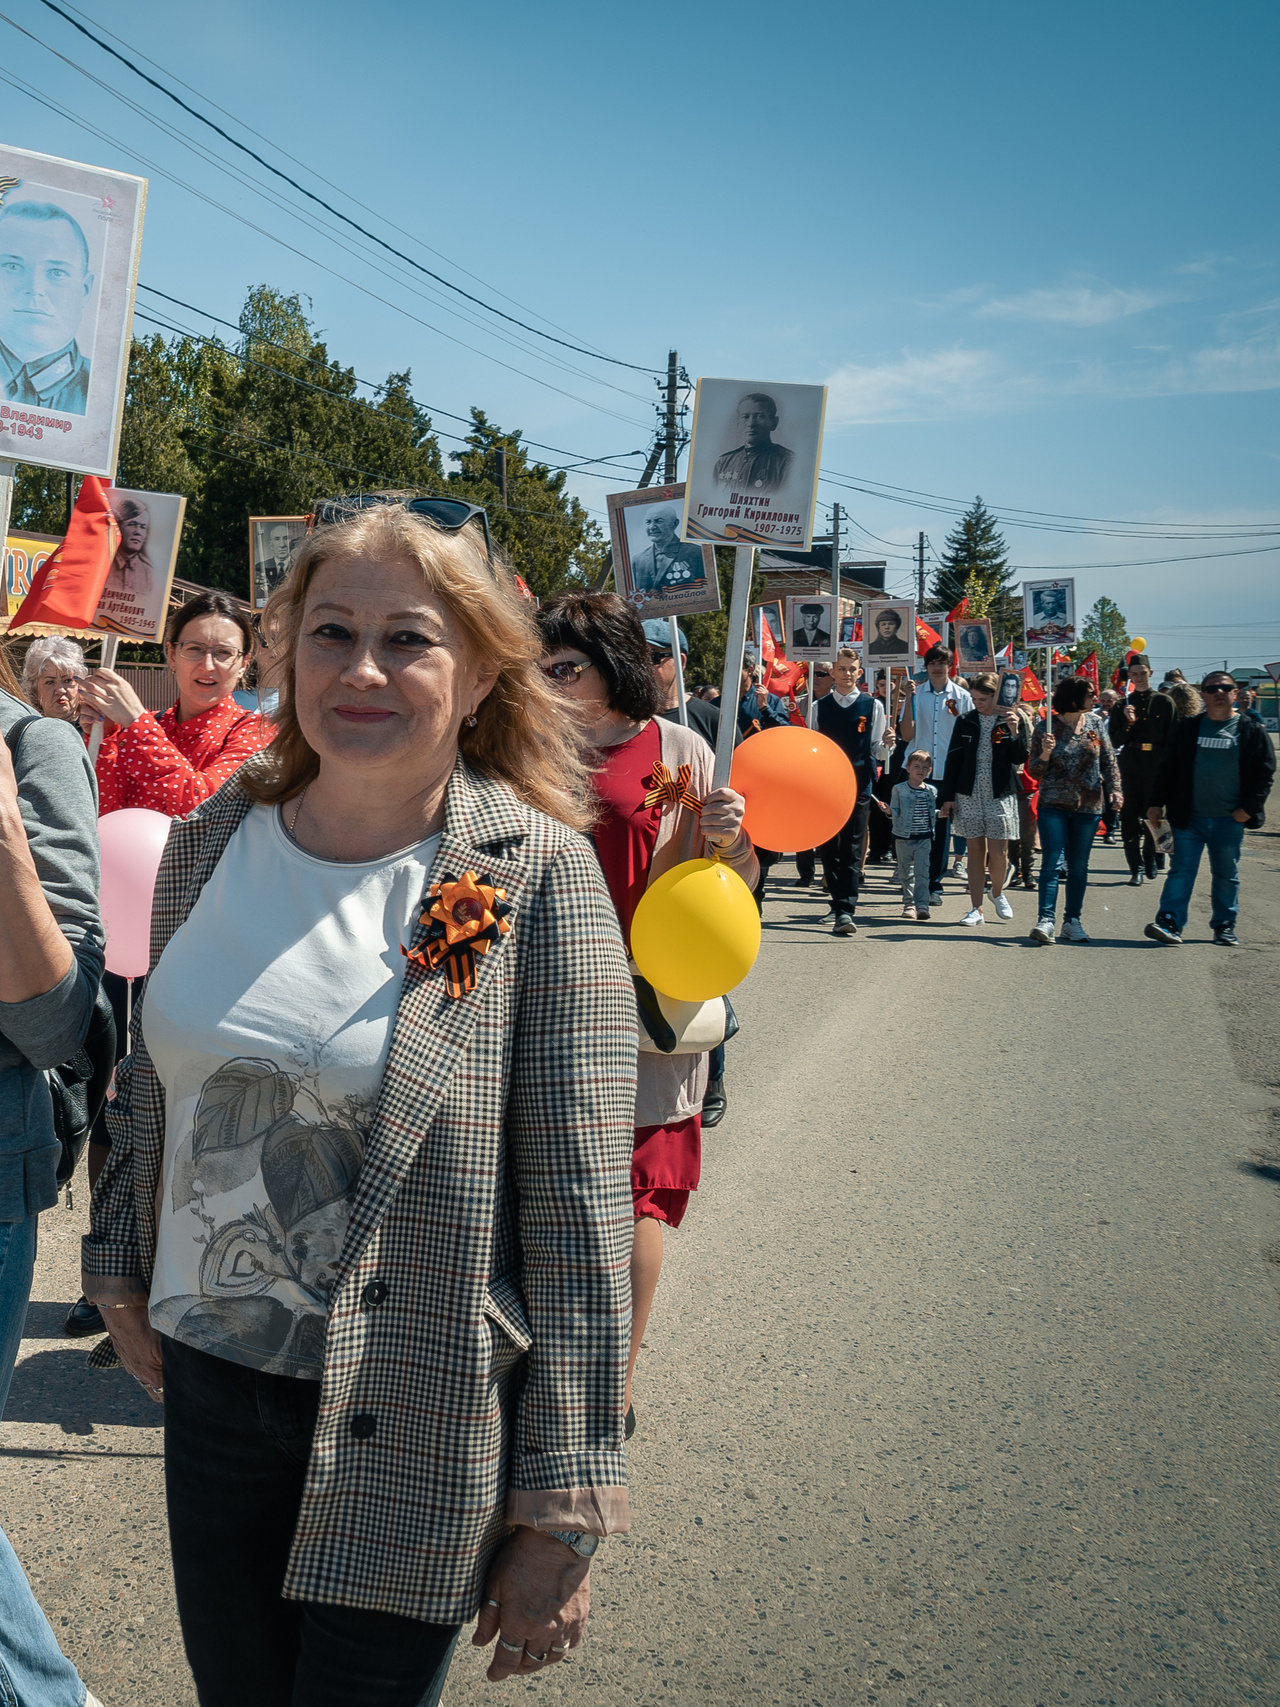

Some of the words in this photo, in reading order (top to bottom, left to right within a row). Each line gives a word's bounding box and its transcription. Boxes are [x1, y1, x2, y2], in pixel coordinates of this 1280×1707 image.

[0, 405, 73, 433] Владимир
[729, 492, 771, 507] Шляхтин
[697, 503, 741, 520] Григорий
[743, 506, 800, 524] Кириллович
[754, 522, 803, 536] 1907-1975
[659, 589, 707, 602] Михайлов
[120, 615, 157, 630] 1905-1945
